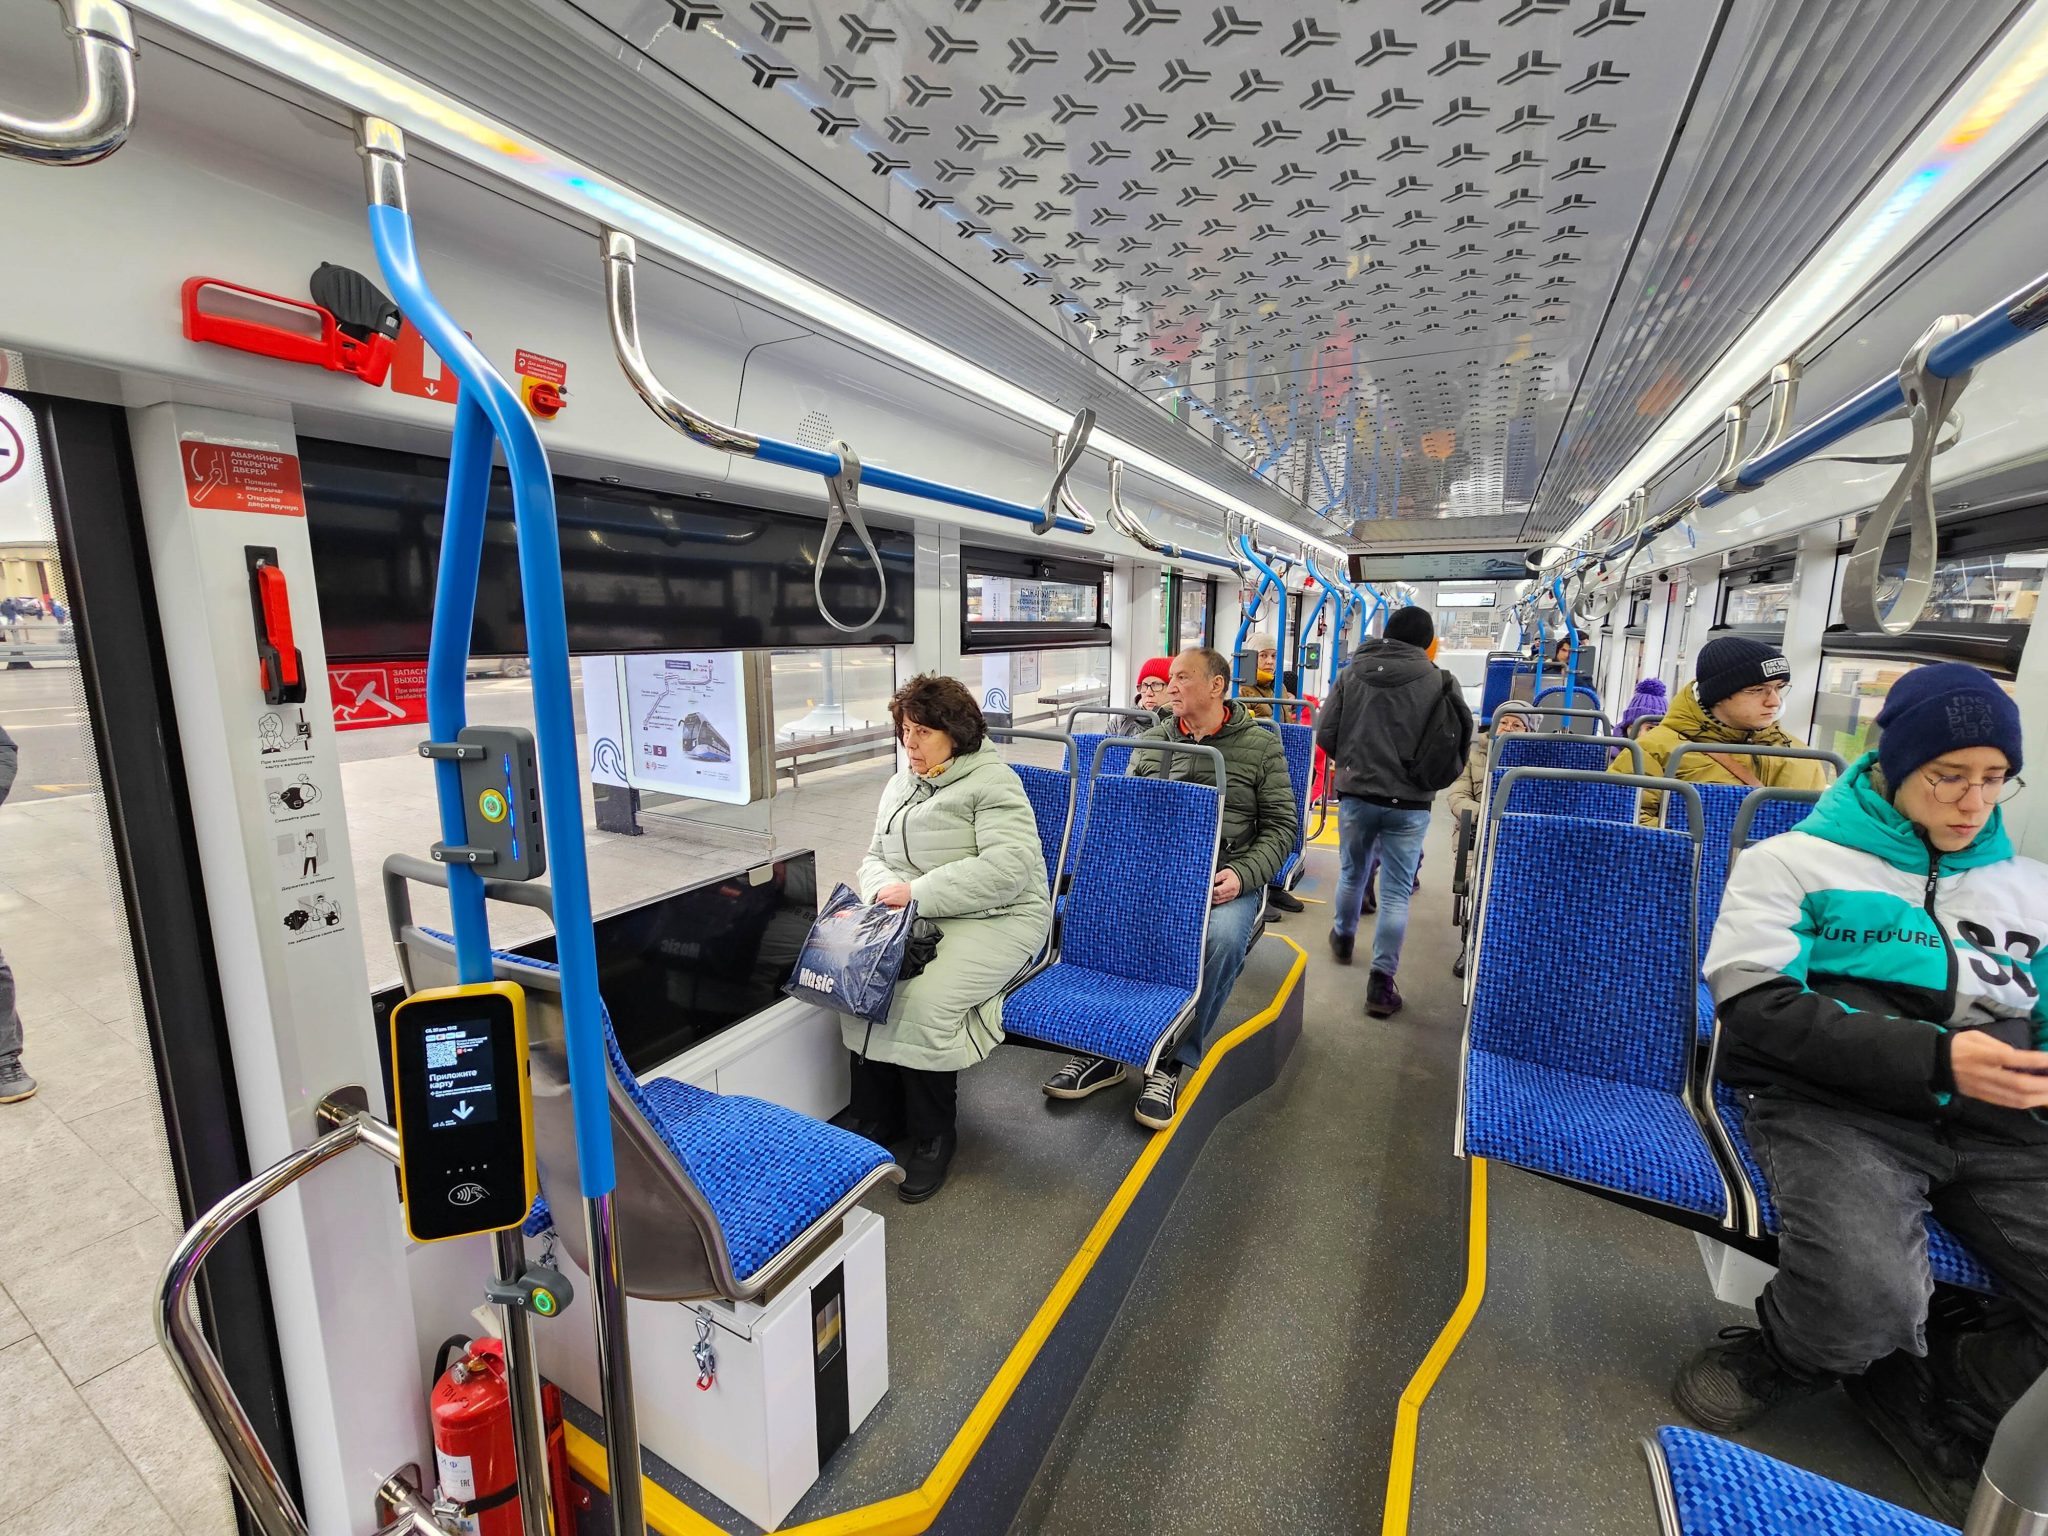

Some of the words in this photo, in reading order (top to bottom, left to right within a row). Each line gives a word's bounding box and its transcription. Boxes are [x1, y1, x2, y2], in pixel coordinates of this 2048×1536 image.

[230, 451, 284, 464] АВАРИЙНОЕ
[231, 459, 279, 470] ОТКРЫТИЕ
[232, 466, 267, 476] ДВЕРЕЙ
[244, 478, 278, 487] Потяните
[247, 494, 281, 503] Откройте
[271, 503, 299, 511] вручную
[394, 676, 424, 684] ВЫХОД
[1946, 704, 1993, 716] best
[1864, 928, 1941, 948] FUURE
[798, 968, 835, 994] Music
[429, 1070, 477, 1082] Приложите
[430, 1080, 454, 1089] карту
